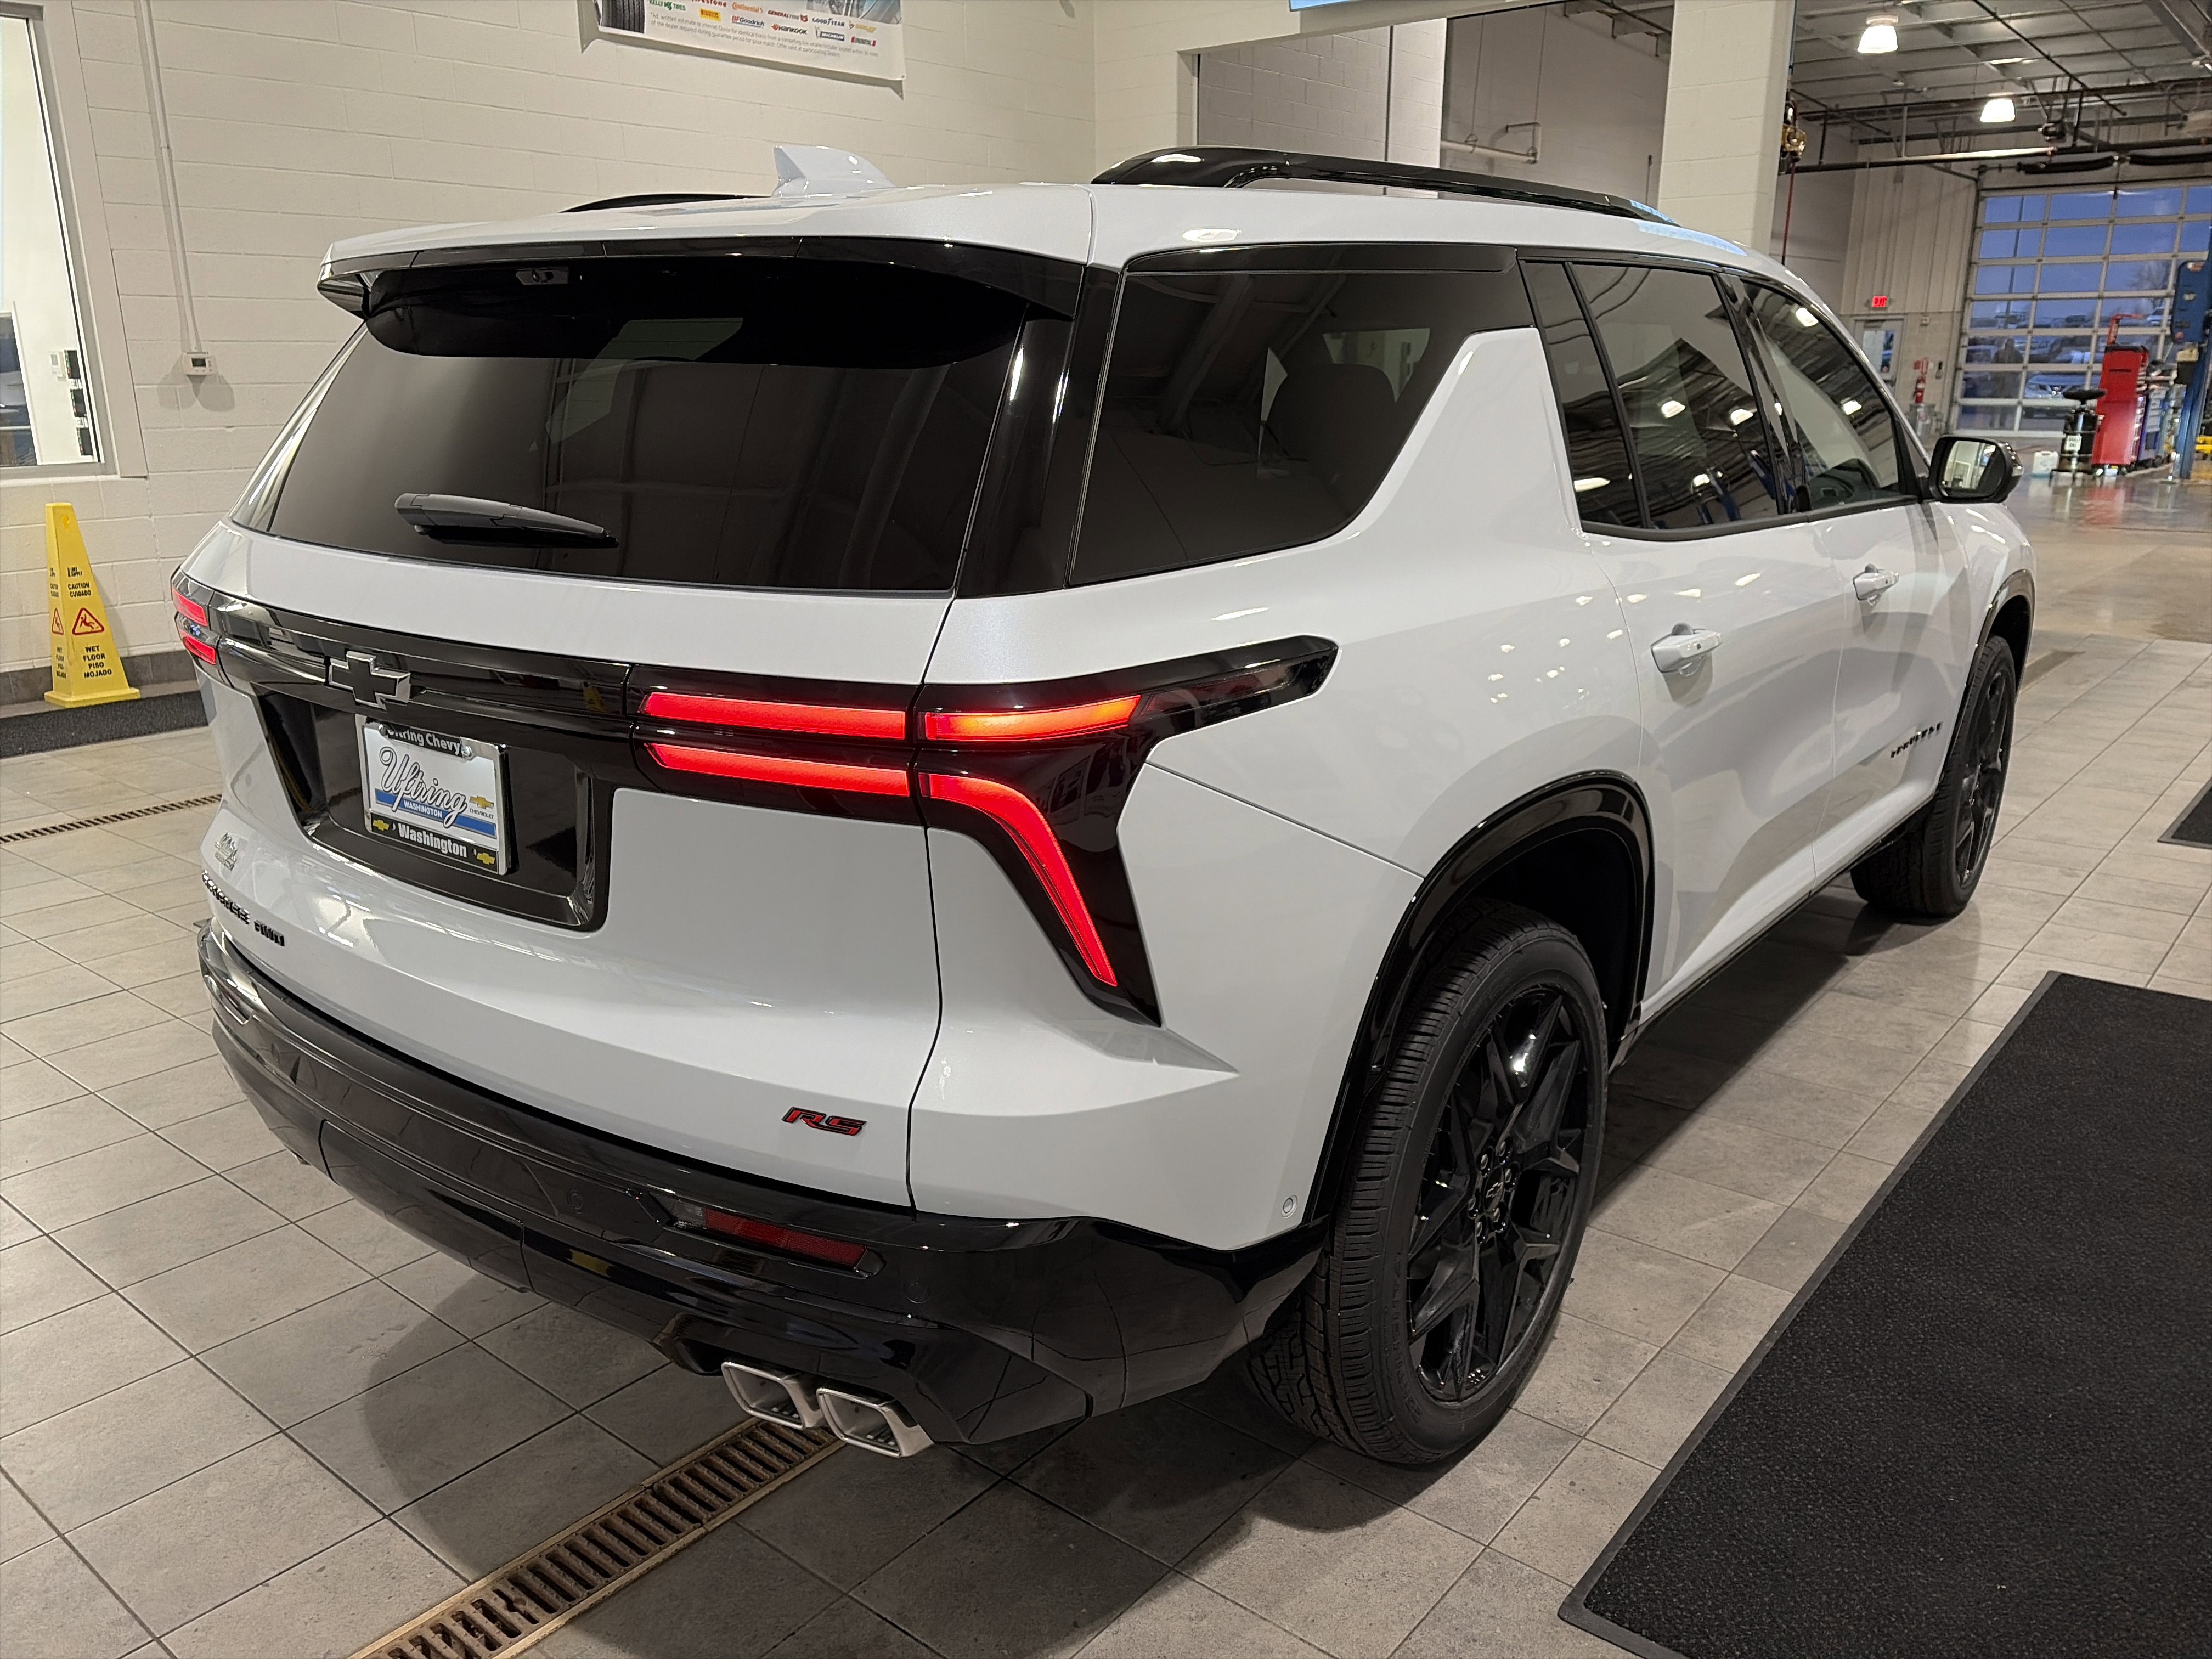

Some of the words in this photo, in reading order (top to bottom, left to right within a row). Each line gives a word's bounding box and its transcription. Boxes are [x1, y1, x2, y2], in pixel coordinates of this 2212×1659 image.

[68, 582, 90, 590] CAUTION
[70, 590, 92, 598] CUIDADO
[83, 653, 105, 662] FLOOR
[88, 662, 104, 670] PISO
[84, 669, 112, 679] MOJADO
[426, 733, 460, 755] Chevy
[379, 746, 467, 828] Uftring
[404, 800, 442, 819] WASHINGTON
[470, 809, 494, 819] CHEVROLET
[398, 823, 467, 858] Washington
[781, 1106, 867, 1136] RS
